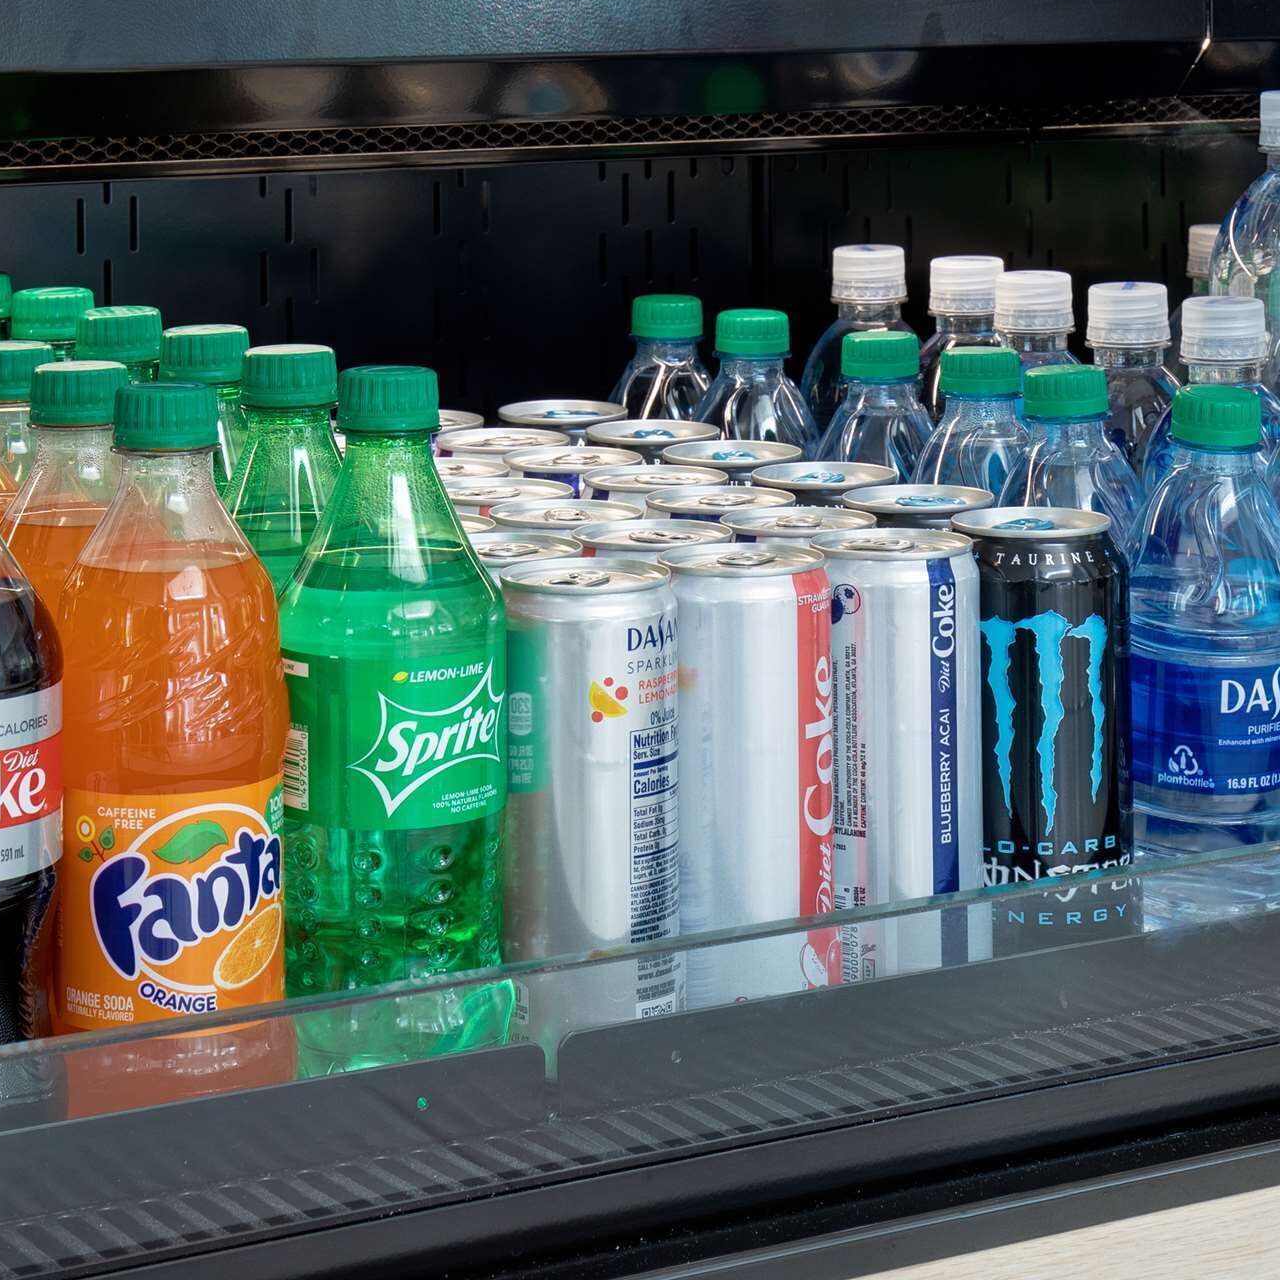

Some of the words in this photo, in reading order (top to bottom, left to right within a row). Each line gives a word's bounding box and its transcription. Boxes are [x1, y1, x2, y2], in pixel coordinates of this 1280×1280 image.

[996, 550, 1096, 566] TAURINE
[932, 584, 955, 658] Coke
[410, 662, 484, 683] LEMON-LIME
[939, 660, 950, 694] Diet
[650, 711, 661, 726] 0%
[662, 707, 675, 722] Juice
[939, 708, 950, 746] ACAI
[375, 706, 496, 776] Sprite
[634, 728, 669, 748] Nutrition
[804, 655, 833, 837] Coke
[1218, 738, 1250, 746] Enhanced
[1252, 737, 1265, 745] with
[3, 749, 39, 773] Diet
[633, 750, 648, 761] Serv.
[650, 747, 661, 757] Size
[634, 774, 670, 794] Calories
[1158, 772, 1210, 788] plantbottle
[1227, 778, 1246, 789] 16.9
[1249, 778, 1259, 788] FL
[1261, 775, 1270, 786] OZ
[432, 800, 450, 808] 100%
[451, 796, 478, 807] NATURAL
[442, 788, 479, 800] LEMON-LIME
[941, 751, 952, 844] BLUEBERRY
[97, 806, 156, 819] CAFFEINE
[462, 800, 487, 811] CAFFEINE
[634, 808, 648, 817] Total
[649, 806, 657, 816] Fat
[114, 819, 143, 830] FREE
[634, 819, 653, 829] Sodium
[634, 832, 648, 841] Total
[649, 829, 661, 838] Carb.
[0, 847, 14, 863] 591
[14, 844, 25, 860] mL
[634, 843, 653, 854] Protein
[816, 842, 833, 914] Diet
[90, 827, 281, 980] Fanta
[66, 986, 101, 1007] ORANGE
[103, 993, 134, 1012] SODA
[139, 982, 217, 1014] ORANGE
[98, 1009, 134, 1023] FLAVORED
